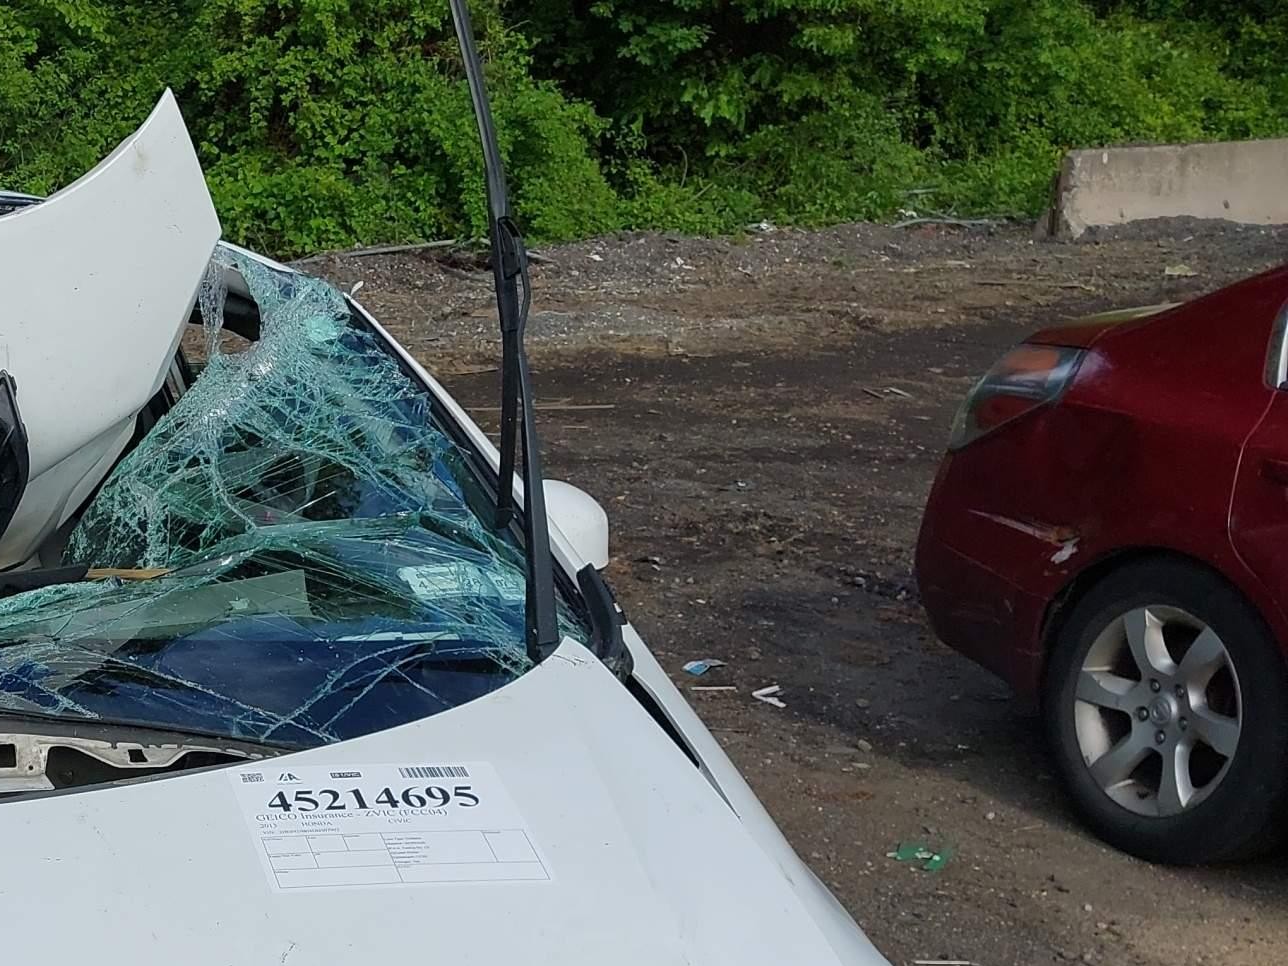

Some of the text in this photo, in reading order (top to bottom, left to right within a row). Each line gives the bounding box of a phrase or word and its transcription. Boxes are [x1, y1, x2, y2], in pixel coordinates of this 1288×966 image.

[268, 786, 479, 812] 45214695
[256, 812, 297, 822] GEICO
[300, 812, 354, 820] Insurance
